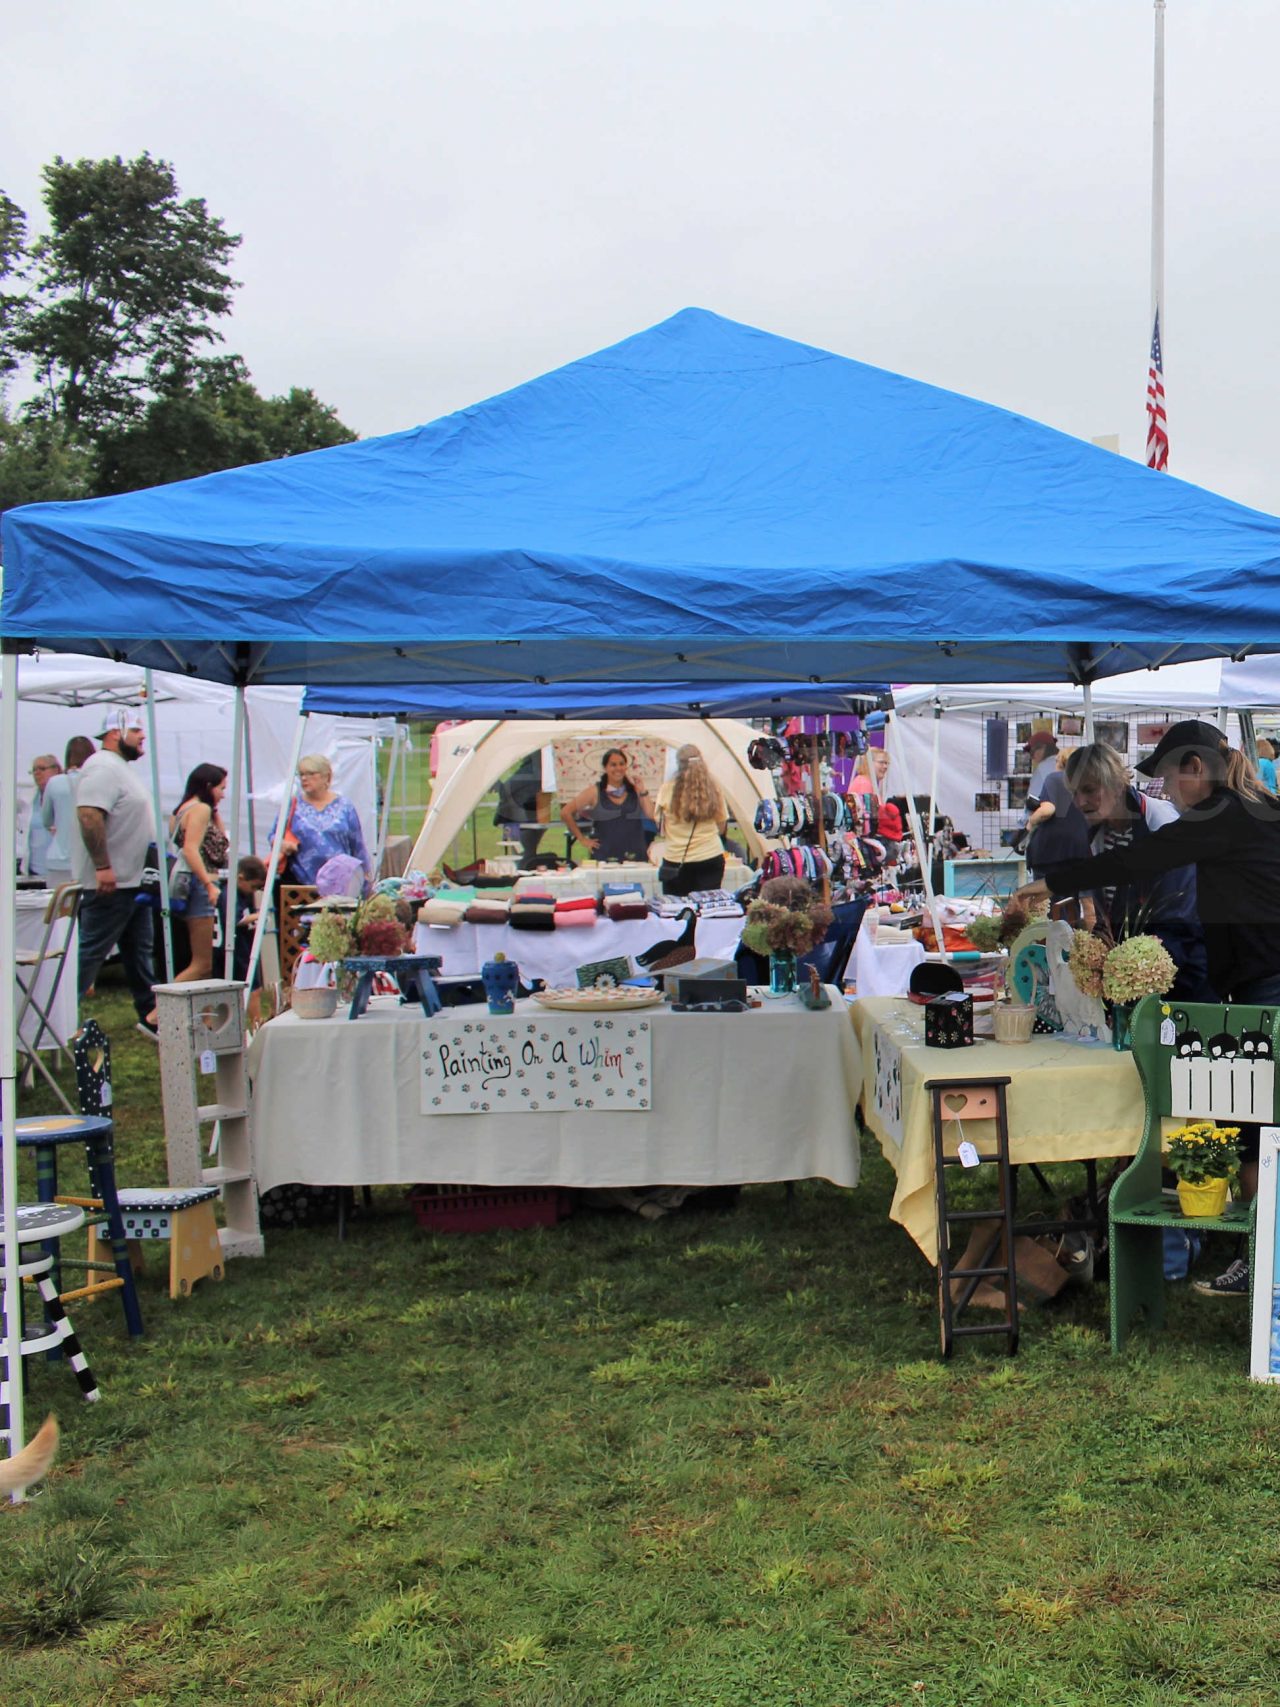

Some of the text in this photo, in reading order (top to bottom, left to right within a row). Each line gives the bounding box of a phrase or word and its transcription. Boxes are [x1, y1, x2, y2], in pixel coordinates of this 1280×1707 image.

[439, 1041, 512, 1090] Painting
[522, 1040, 544, 1066] On
[579, 1036, 624, 1078] Whim
[1261, 1155, 1273, 1168] Be
